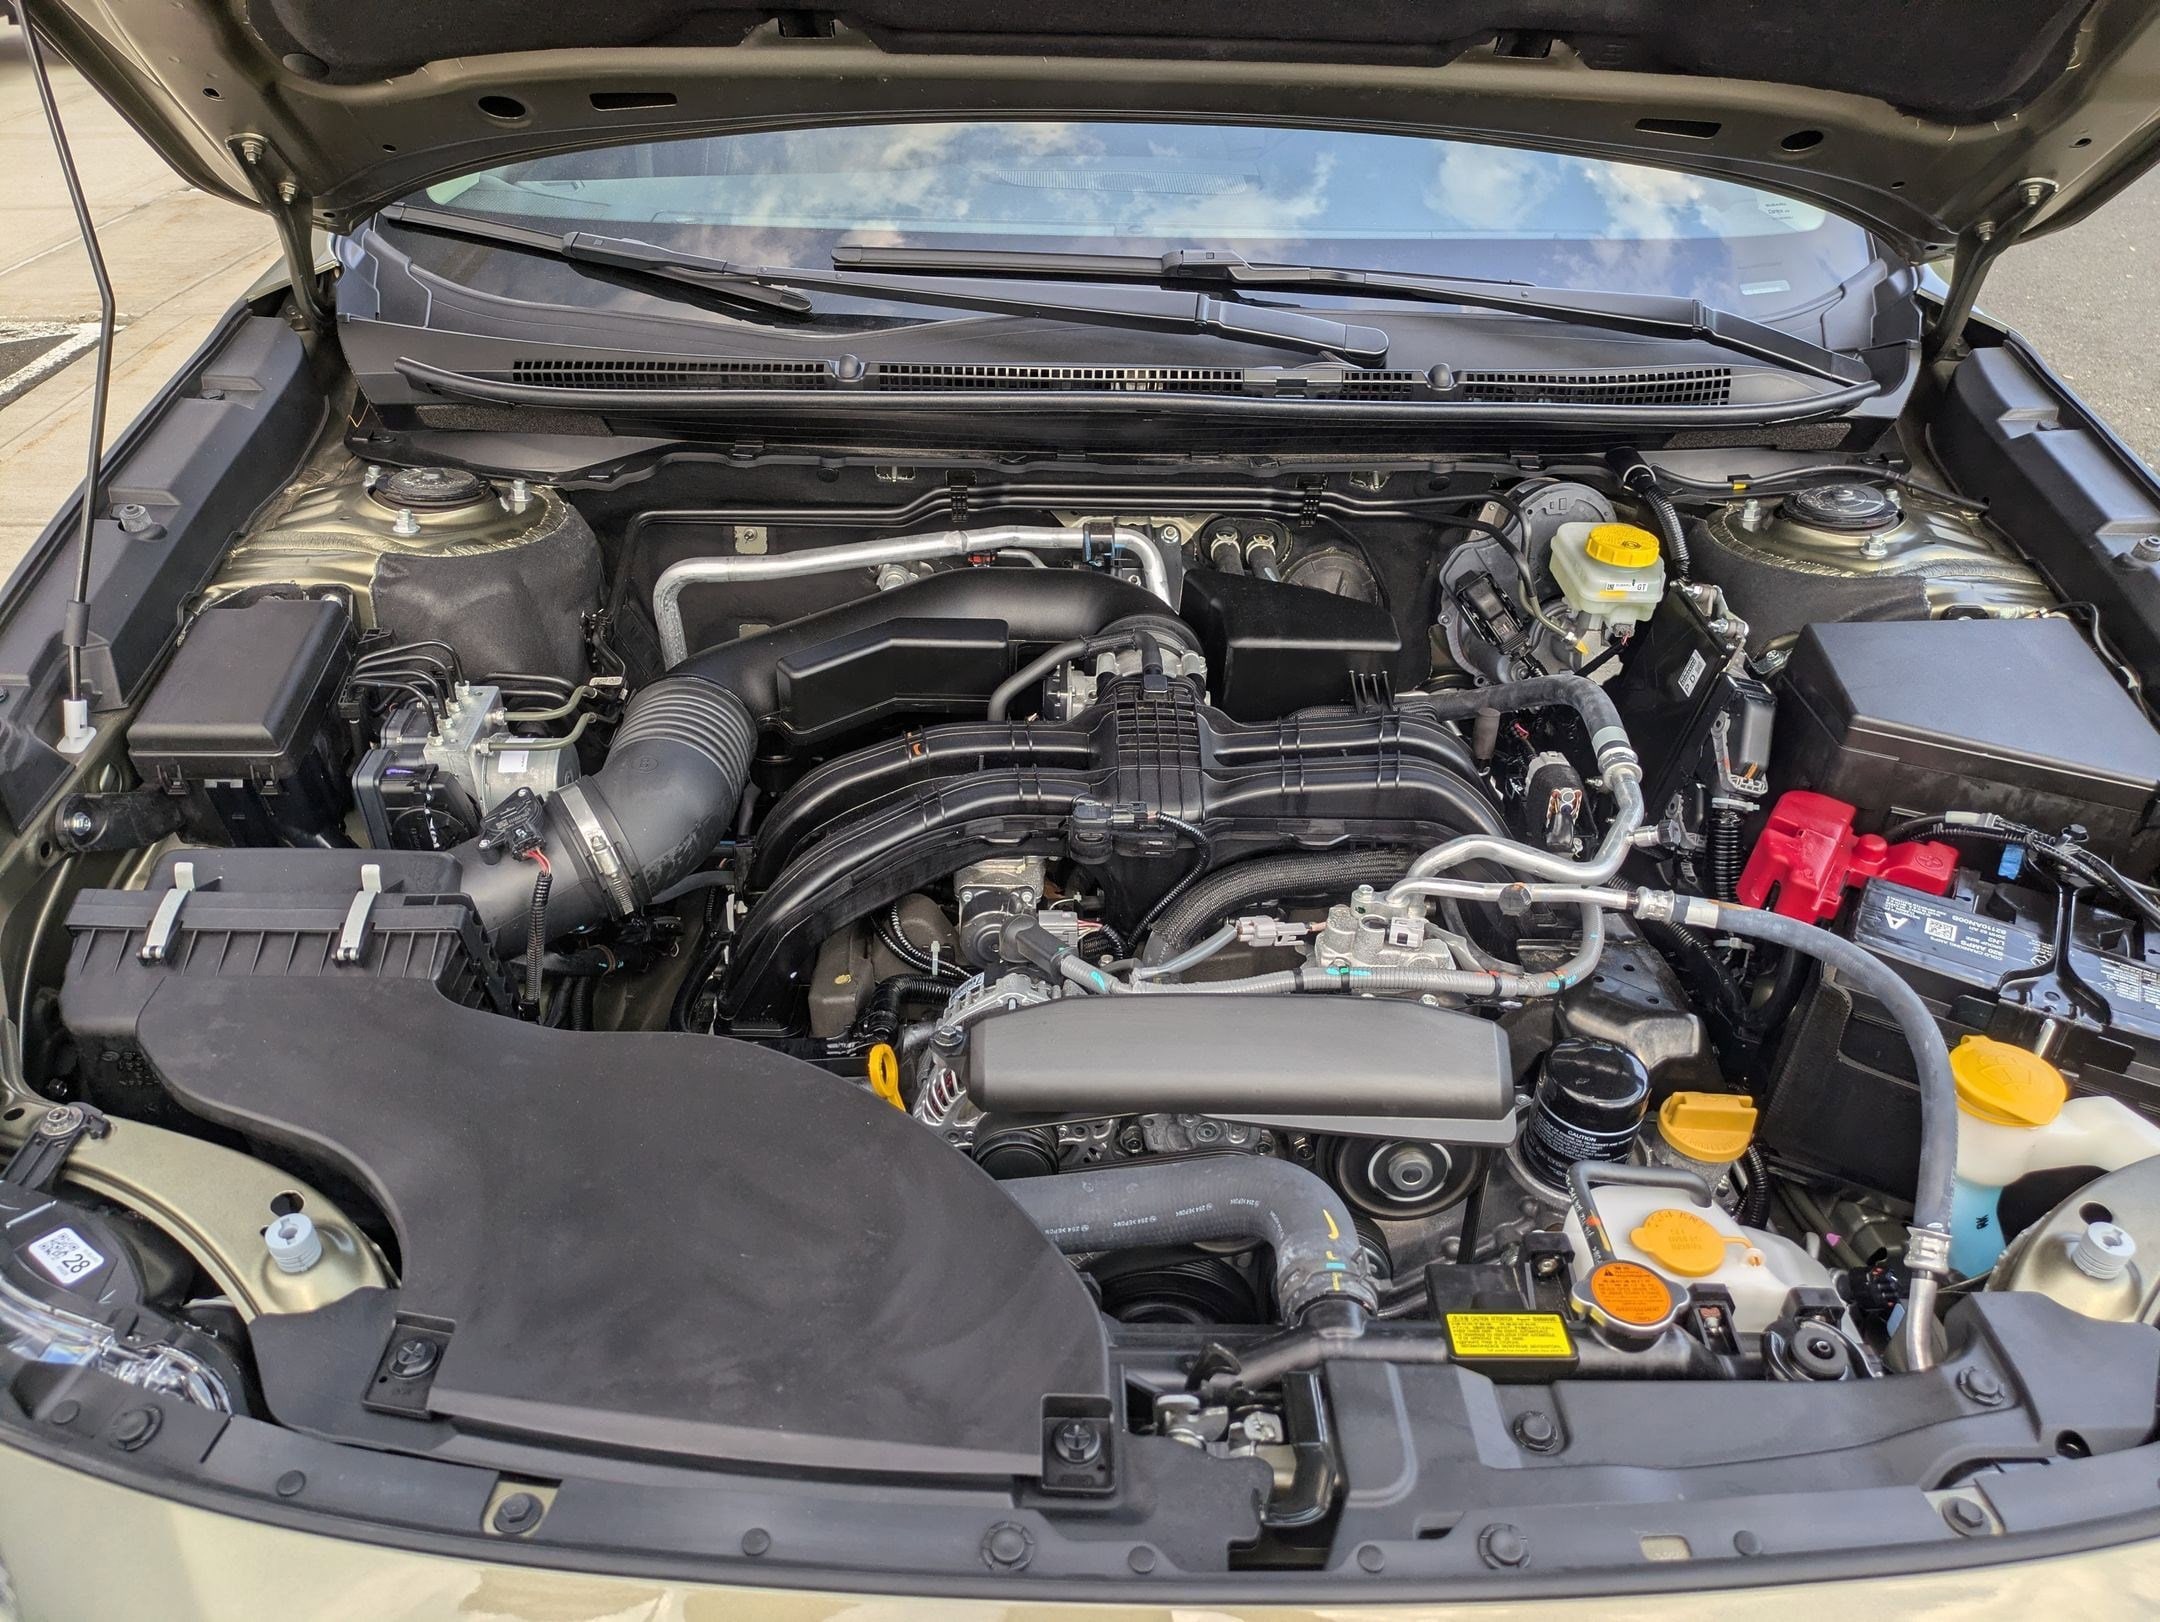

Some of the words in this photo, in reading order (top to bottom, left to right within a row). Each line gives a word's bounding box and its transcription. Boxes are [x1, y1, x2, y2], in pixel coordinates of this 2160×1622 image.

[1960, 940, 1986, 950] AMPS
[1988, 936, 2004, 946] LN2
[1568, 1130, 1596, 1142] CAUTION
[62, 1254, 90, 1274] 28
